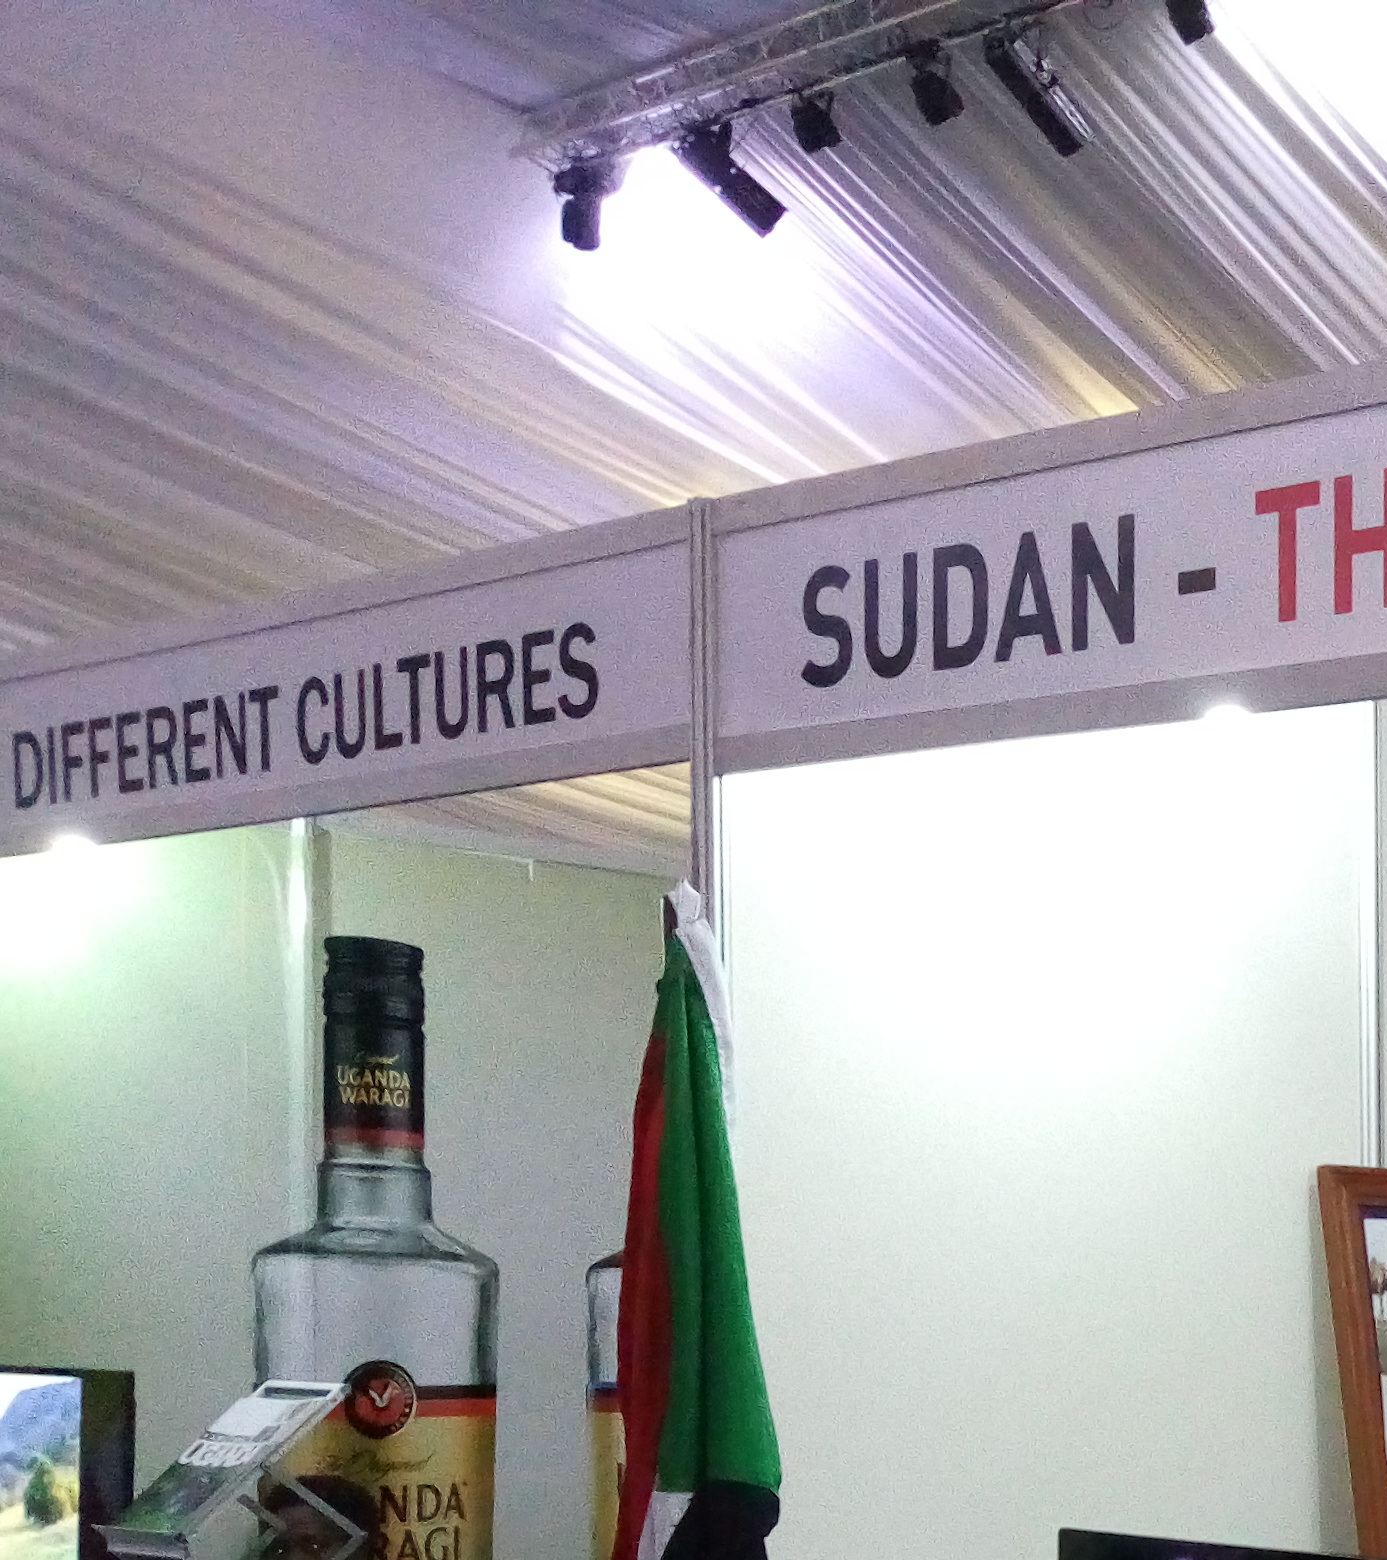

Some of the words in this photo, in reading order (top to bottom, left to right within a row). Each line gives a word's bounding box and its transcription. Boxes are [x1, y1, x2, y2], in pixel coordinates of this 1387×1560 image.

[799, 513, 1137, 690] SUDAN
[1178, 567, 1216, 594] -
[12, 685, 279, 810] DIFFERENT
[295, 621, 600, 765] CULTURES
[337, 1065, 410, 1089] UGANDA
[340, 1086, 410, 1108] WARAGI
